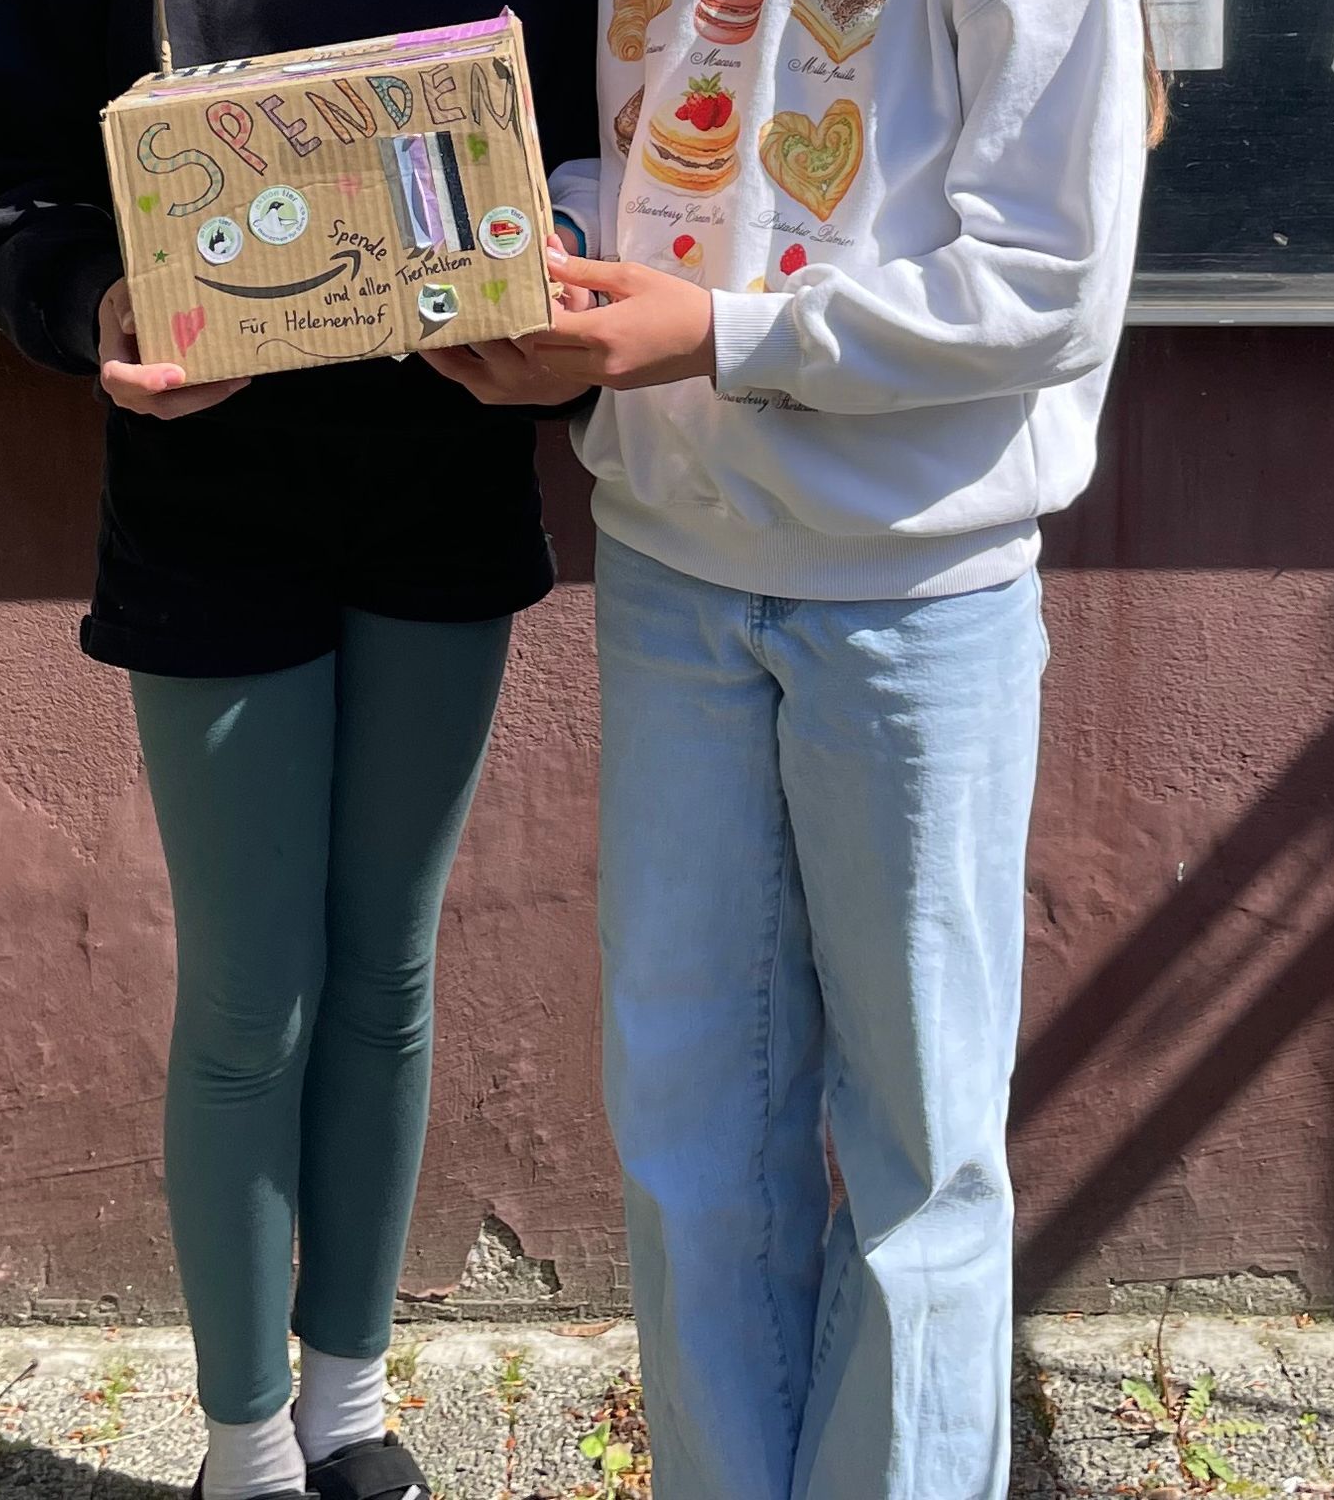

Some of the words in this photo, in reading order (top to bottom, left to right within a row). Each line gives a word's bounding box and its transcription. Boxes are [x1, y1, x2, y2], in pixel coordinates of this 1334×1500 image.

[690, 48, 742, 69] Macaron
[787, 56, 857, 83] Mille-feuille
[136, 57, 519, 217] SPENDEN
[625, 196, 683, 225] Strawberry
[684, 203, 711, 224] Cream
[749, 211, 811, 238] Pistachio
[327, 219, 388, 262] Spende
[324, 284, 350, 306] und
[359, 277, 392, 296] allen
[239, 317, 269, 337] Für
[285, 303, 388, 332] Helenenhof
